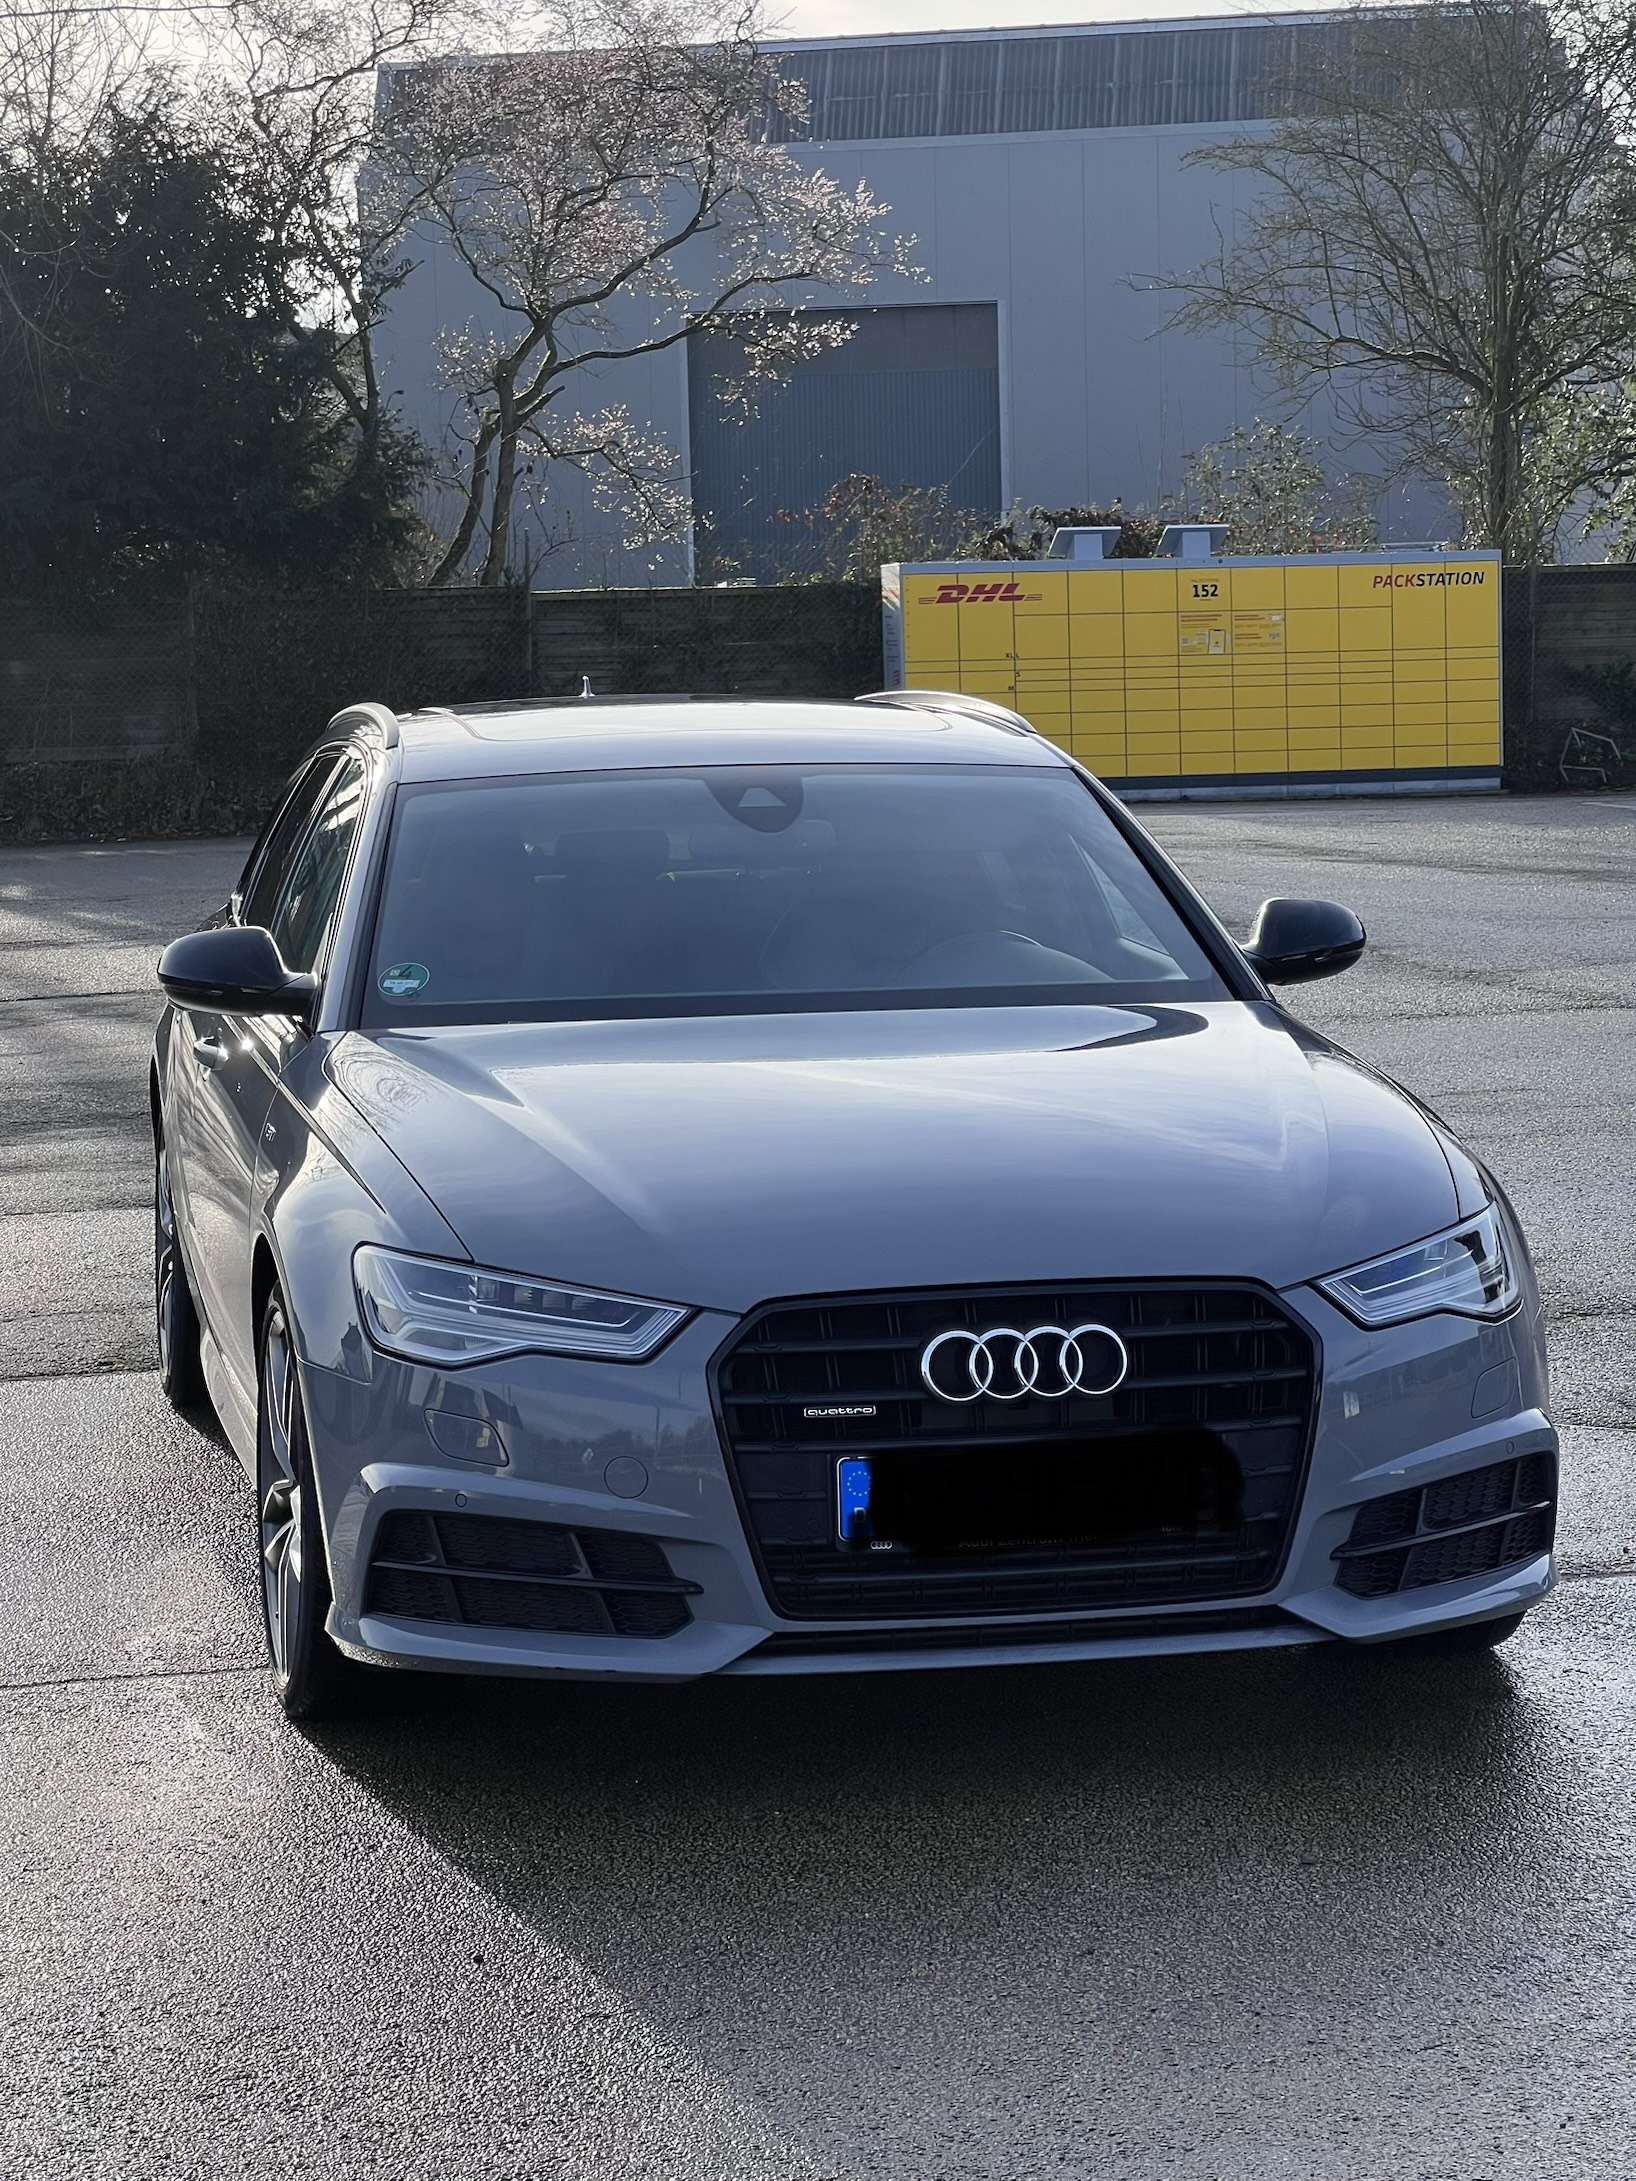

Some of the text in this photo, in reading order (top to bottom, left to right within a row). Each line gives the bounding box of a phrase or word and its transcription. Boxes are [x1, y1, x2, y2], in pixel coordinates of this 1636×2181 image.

[1372, 571, 1485, 589] PACKSTATION
[936, 583, 1027, 604] DHL
[1193, 584, 1218, 598] 152
[807, 1407, 873, 1416] quattro
